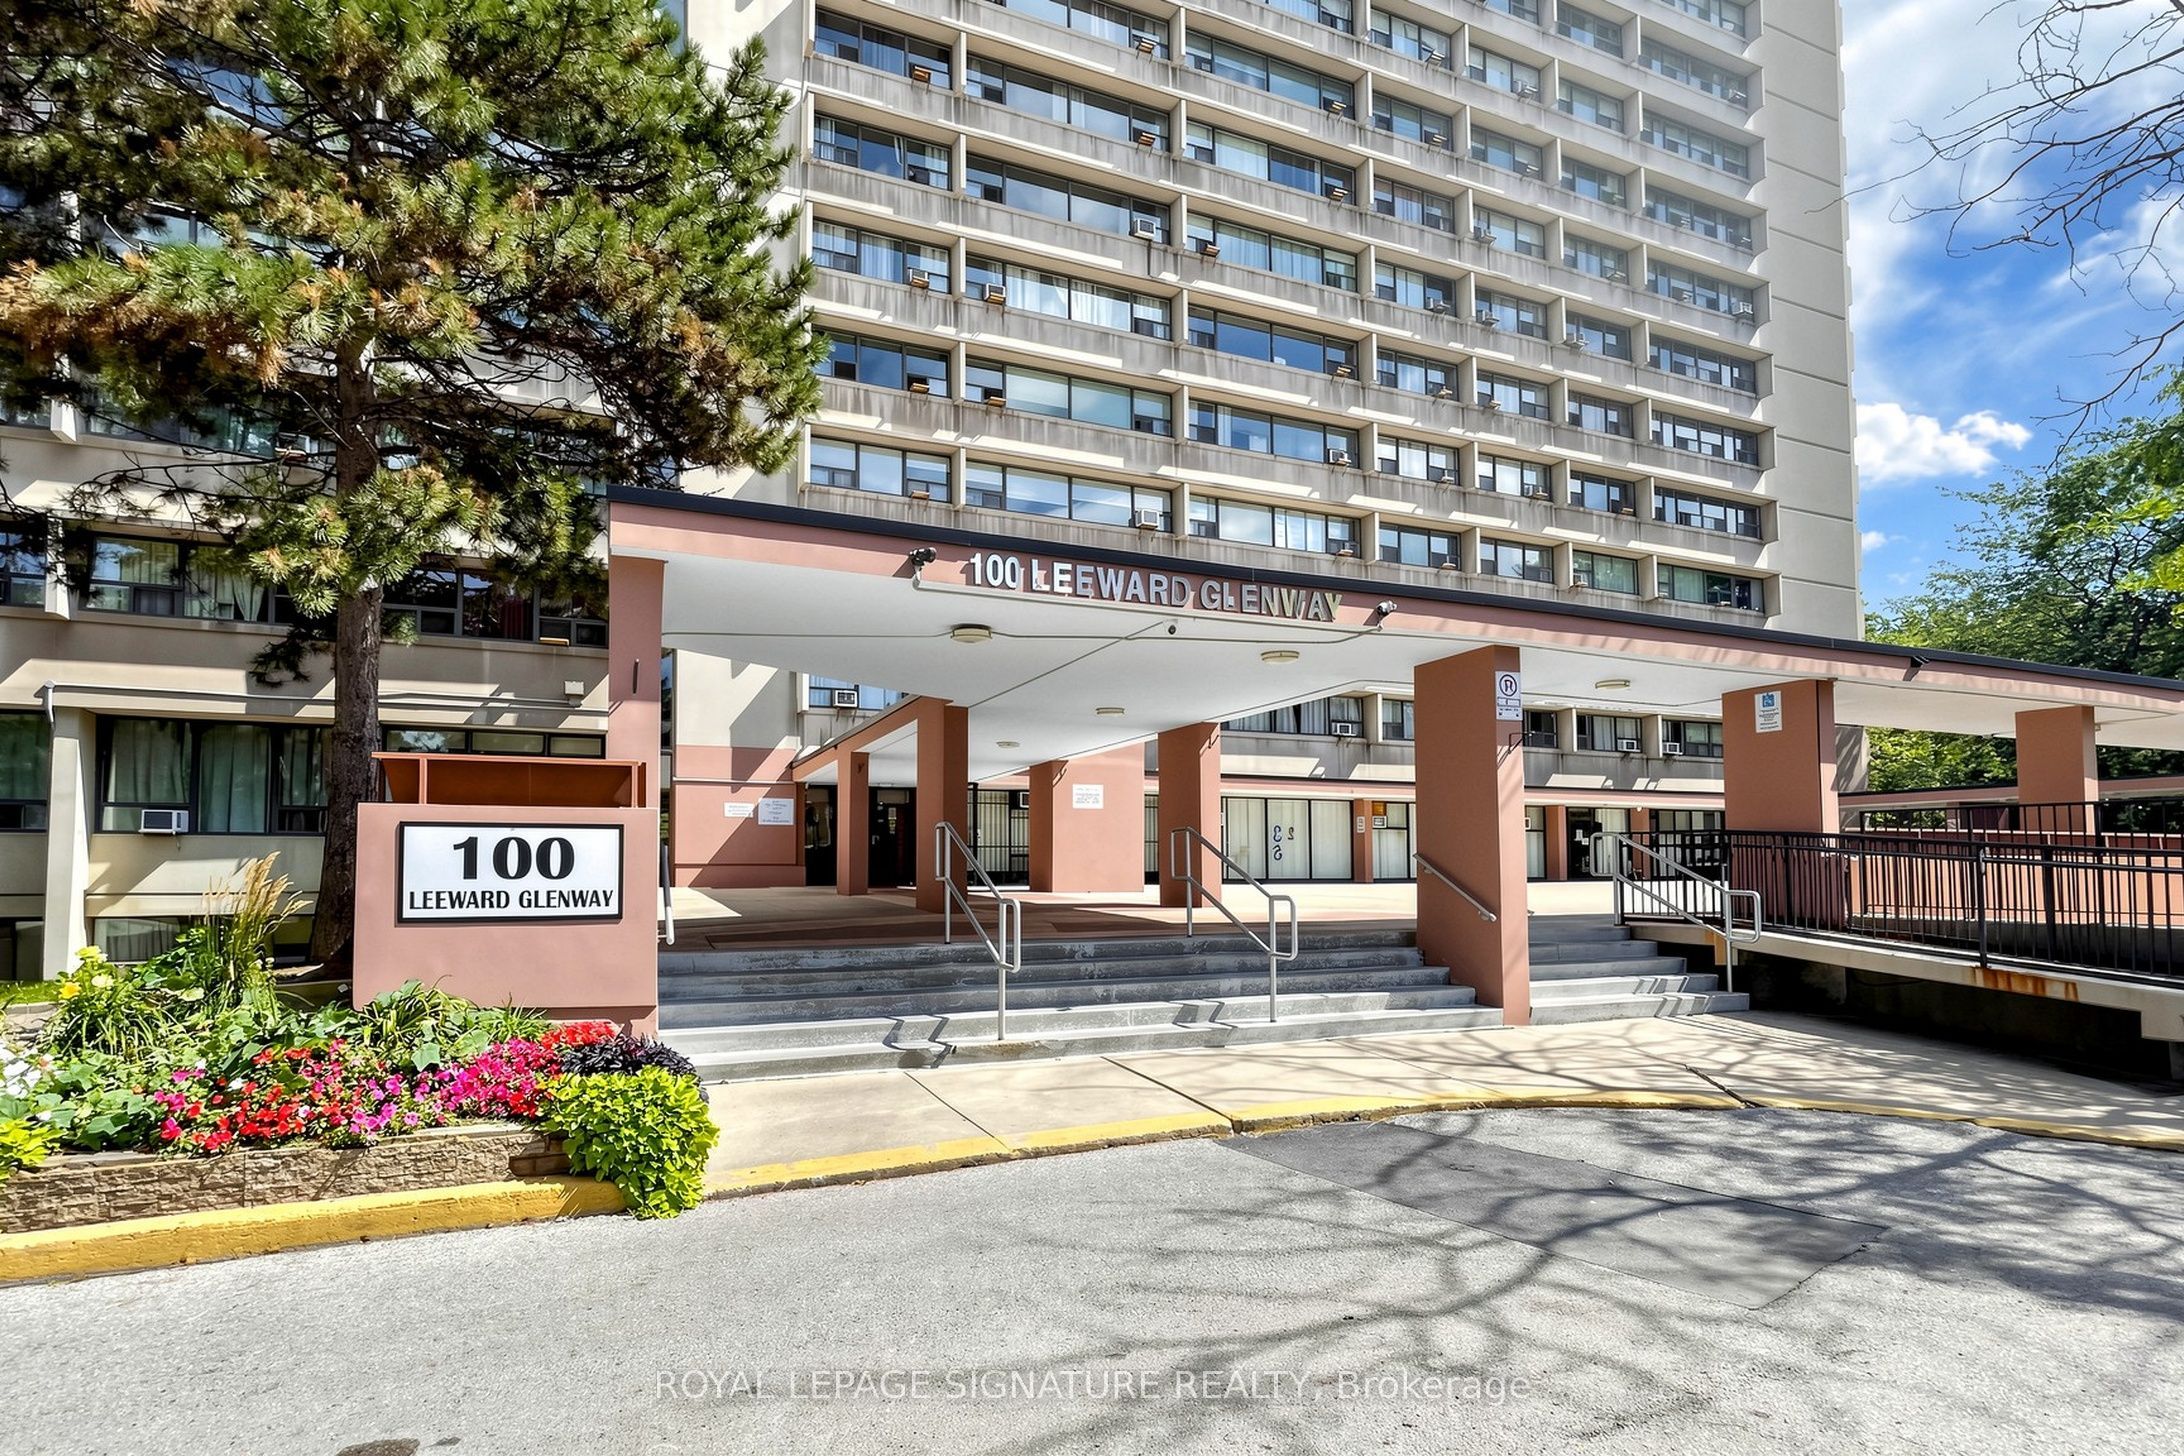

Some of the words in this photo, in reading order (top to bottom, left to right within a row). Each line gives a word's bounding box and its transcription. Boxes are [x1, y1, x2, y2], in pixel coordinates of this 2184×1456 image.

[970, 552, 1021, 589] 100
[1031, 558, 1193, 607] LEEWARD
[1200, 579, 1343, 622] GLENWAY
[453, 836, 575, 880] 100
[409, 890, 510, 910] LEEWARD
[518, 890, 614, 908] GLENWAY
